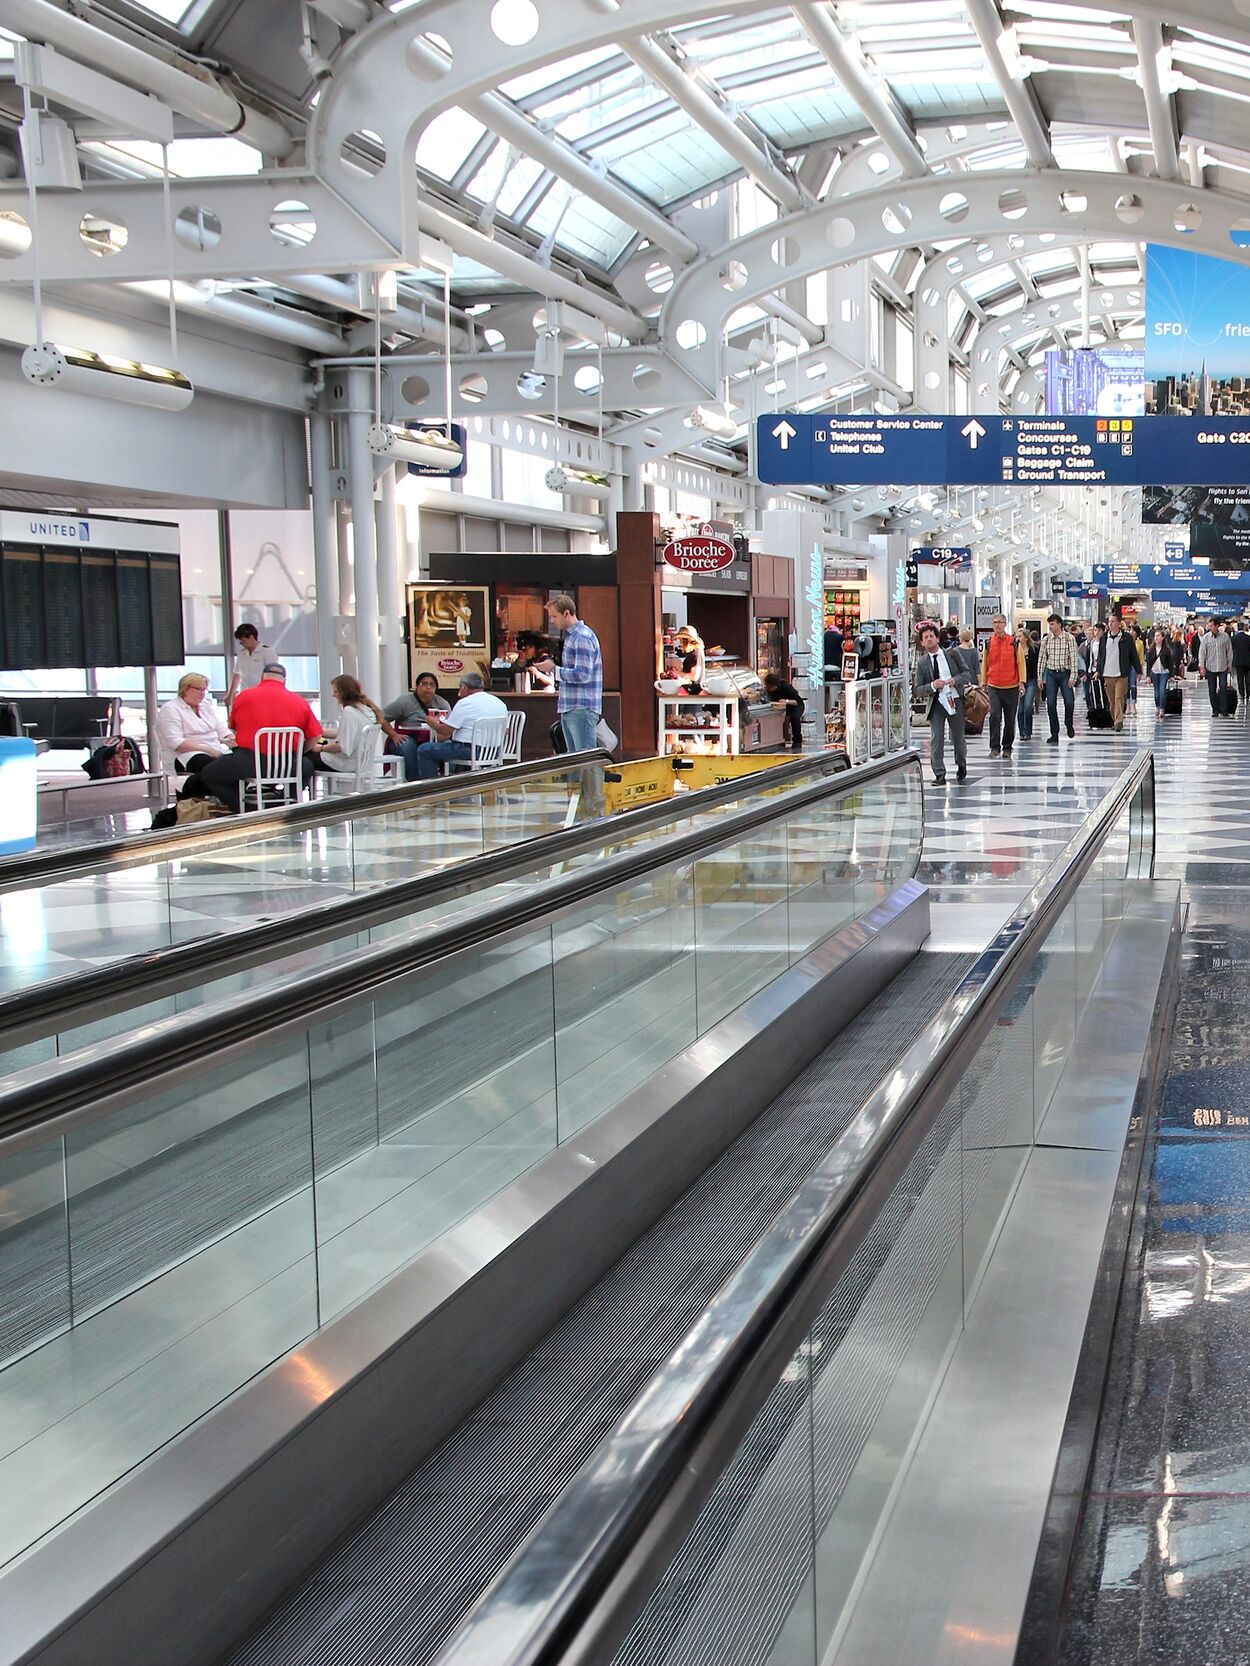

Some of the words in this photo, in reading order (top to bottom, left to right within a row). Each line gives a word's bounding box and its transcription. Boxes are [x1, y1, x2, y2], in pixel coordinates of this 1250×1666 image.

[1154, 322, 1182, 336] SFO
[830, 420, 875, 429] Customer
[876, 420, 911, 429] Service
[912, 420, 944, 429] Center
[1017, 420, 1066, 430] Terminals
[830, 431, 882, 442] Telephones
[1017, 432, 1078, 443] Concourses
[1197, 432, 1226, 444] Gate
[830, 444, 860, 454] United
[862, 444, 885, 454] Club
[1017, 445, 1048, 455] Gates
[1051, 445, 1091, 455] C1-C19
[1017, 457, 1062, 469] Baggage
[1065, 457, 1094, 468] Claim
[1017, 469, 1054, 480] Ground
[1058, 469, 1106, 481] Transport
[1208, 488, 1227, 496] flights
[29, 522, 77, 537] UNITED
[674, 541, 726, 557] Brioche
[931, 549, 953, 559] C19
[1174, 549, 1184, 559] B
[680, 554, 719, 569] Dorée
[806, 542, 824, 608] News
[807, 607, 824, 688] Hudson
